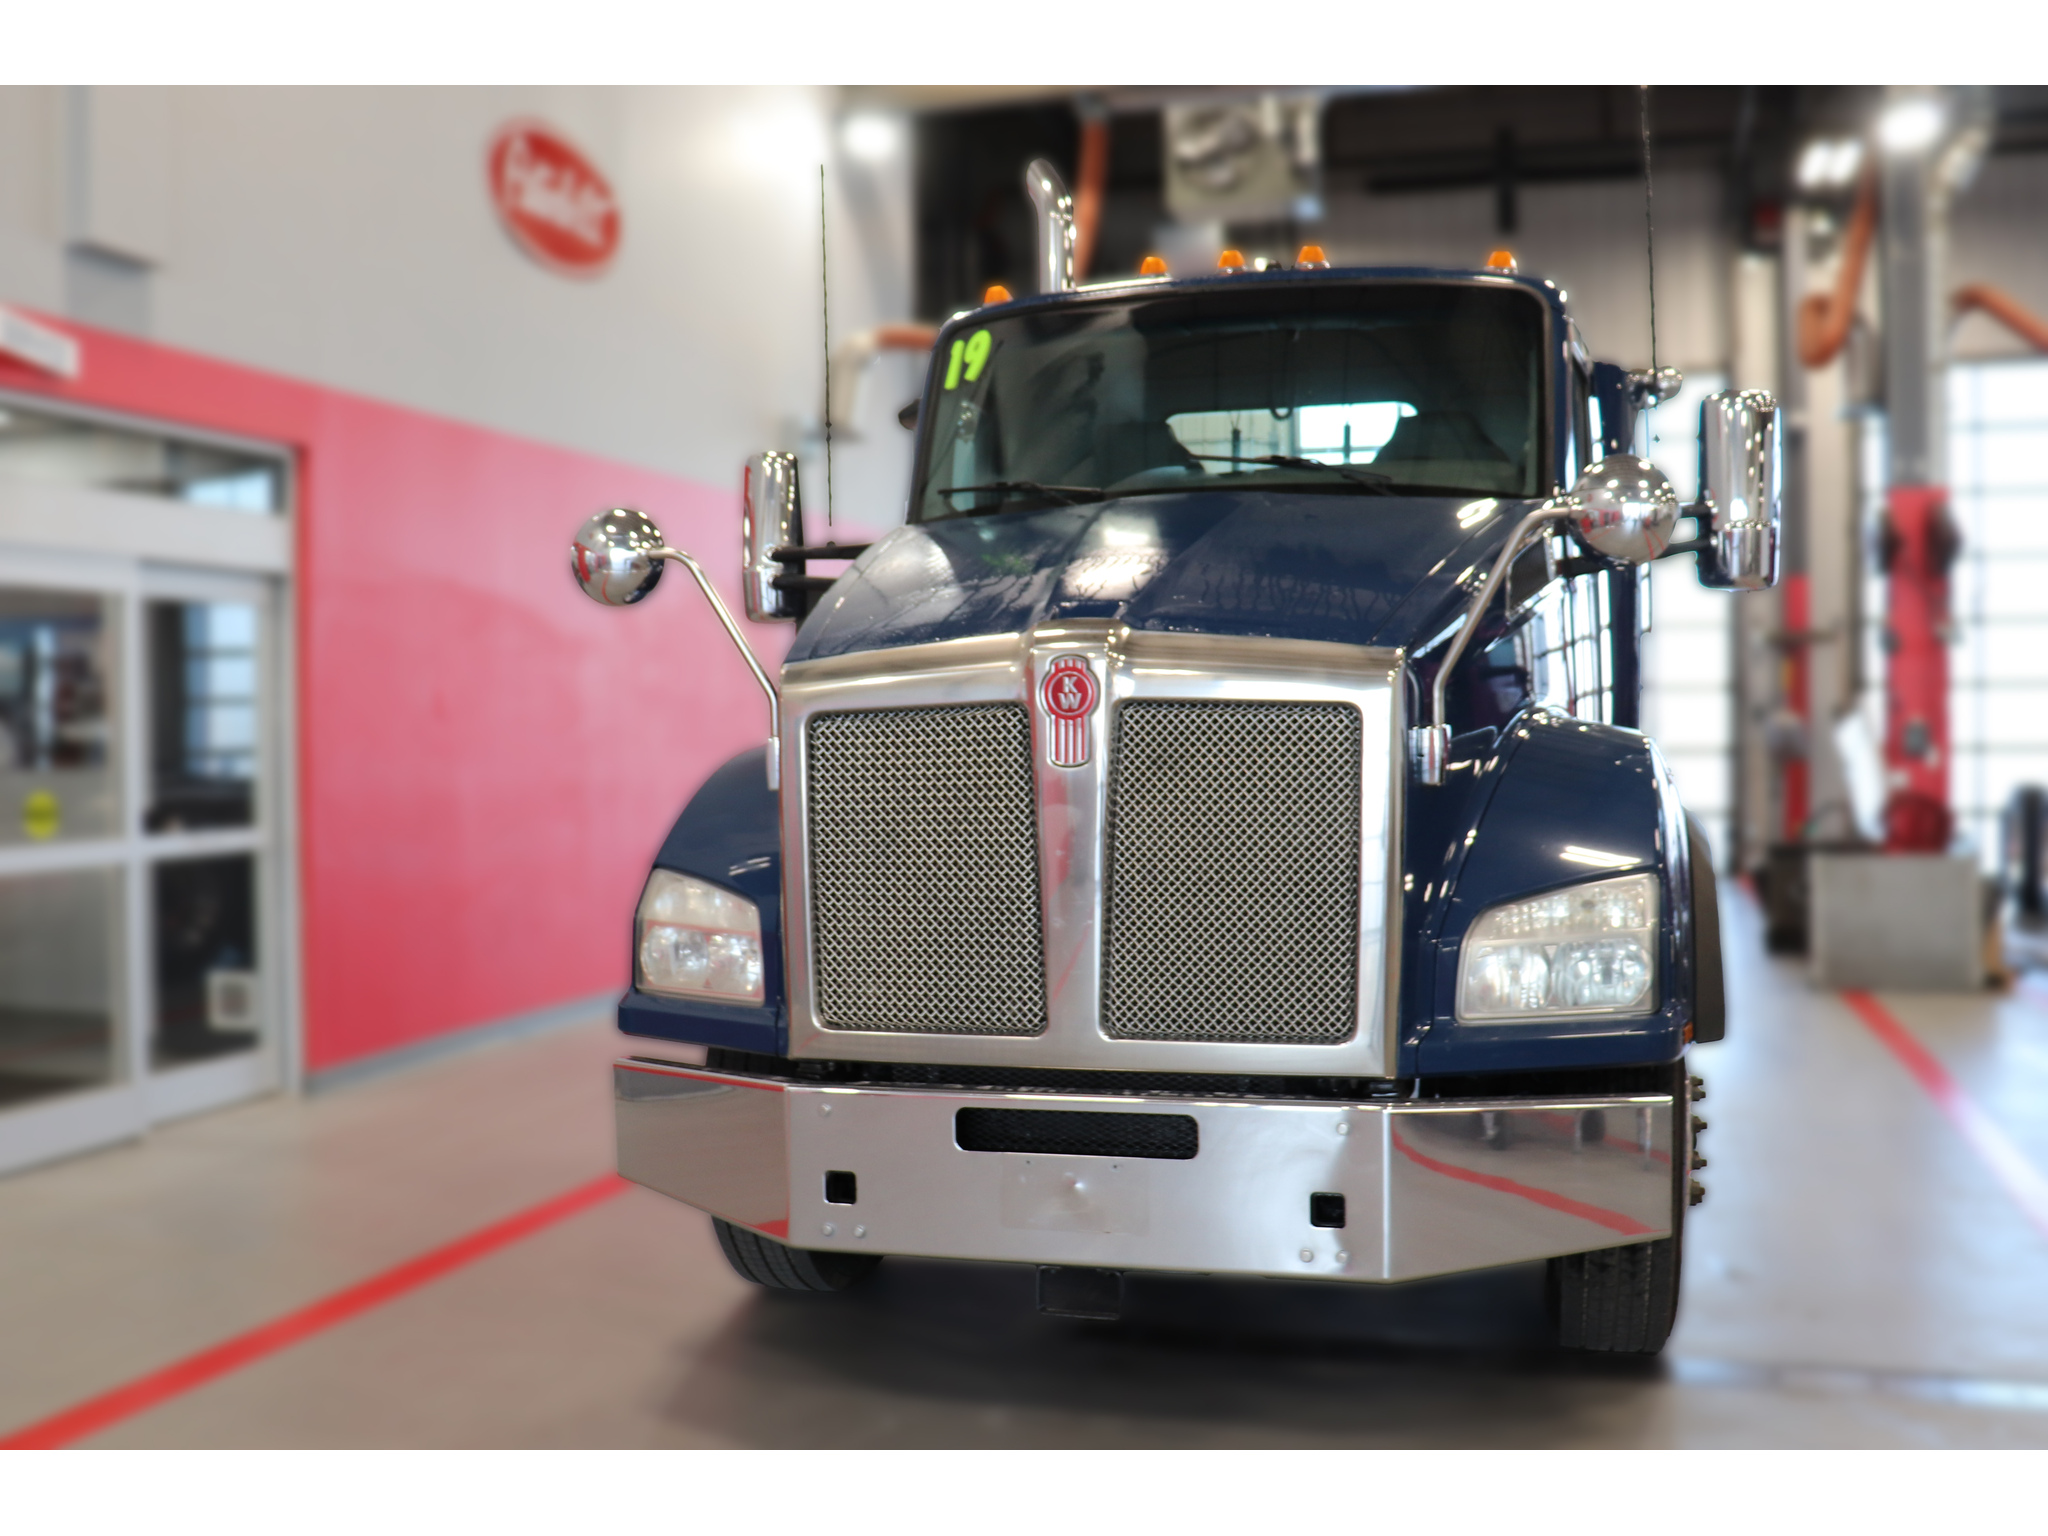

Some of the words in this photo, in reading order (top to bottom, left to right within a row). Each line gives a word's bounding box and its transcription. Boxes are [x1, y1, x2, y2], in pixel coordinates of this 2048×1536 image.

[944, 329, 992, 390] 19
[1063, 677, 1078, 693] K
[1059, 693, 1082, 709] W
